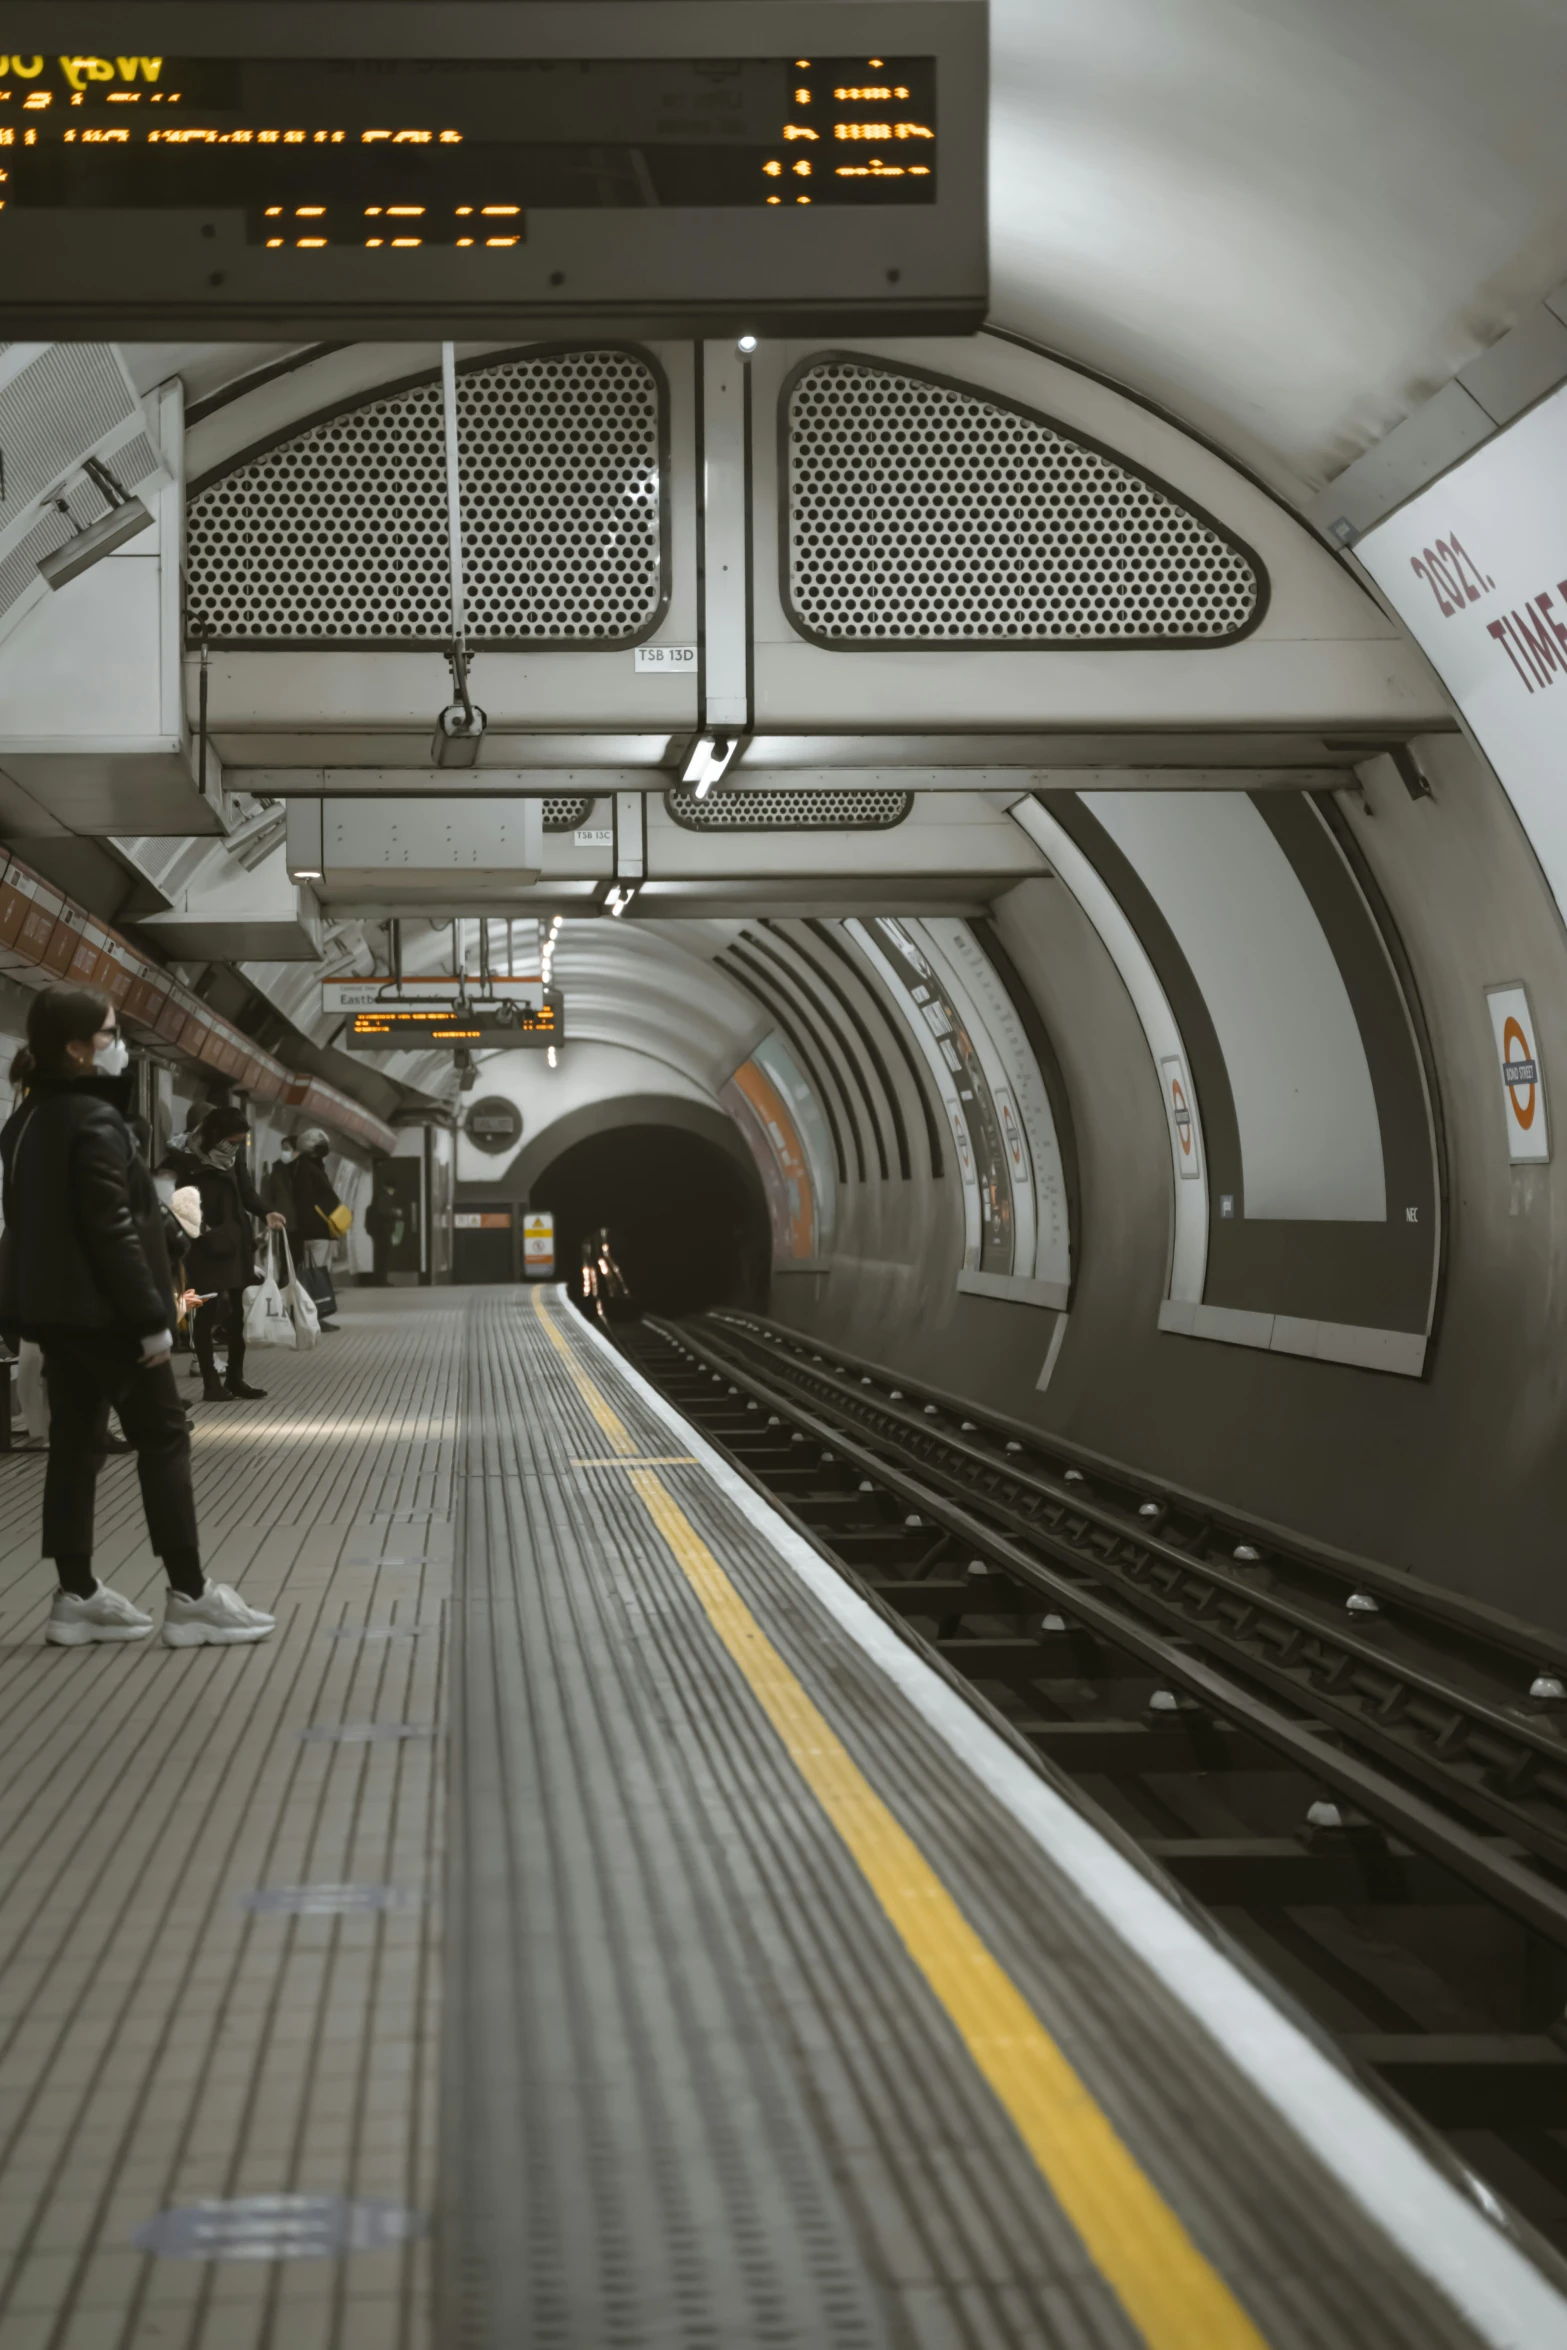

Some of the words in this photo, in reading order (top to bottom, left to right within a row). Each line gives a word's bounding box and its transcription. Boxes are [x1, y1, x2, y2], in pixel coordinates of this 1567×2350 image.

[1410, 531, 1496, 618] 2021.
[639, 649, 664, 661] TSB
[669, 649, 694, 661] 13D
[577, 831, 593, 840] TSB
[595, 831, 611, 840] 13C
[1406, 1207, 1418, 1223] NEC
